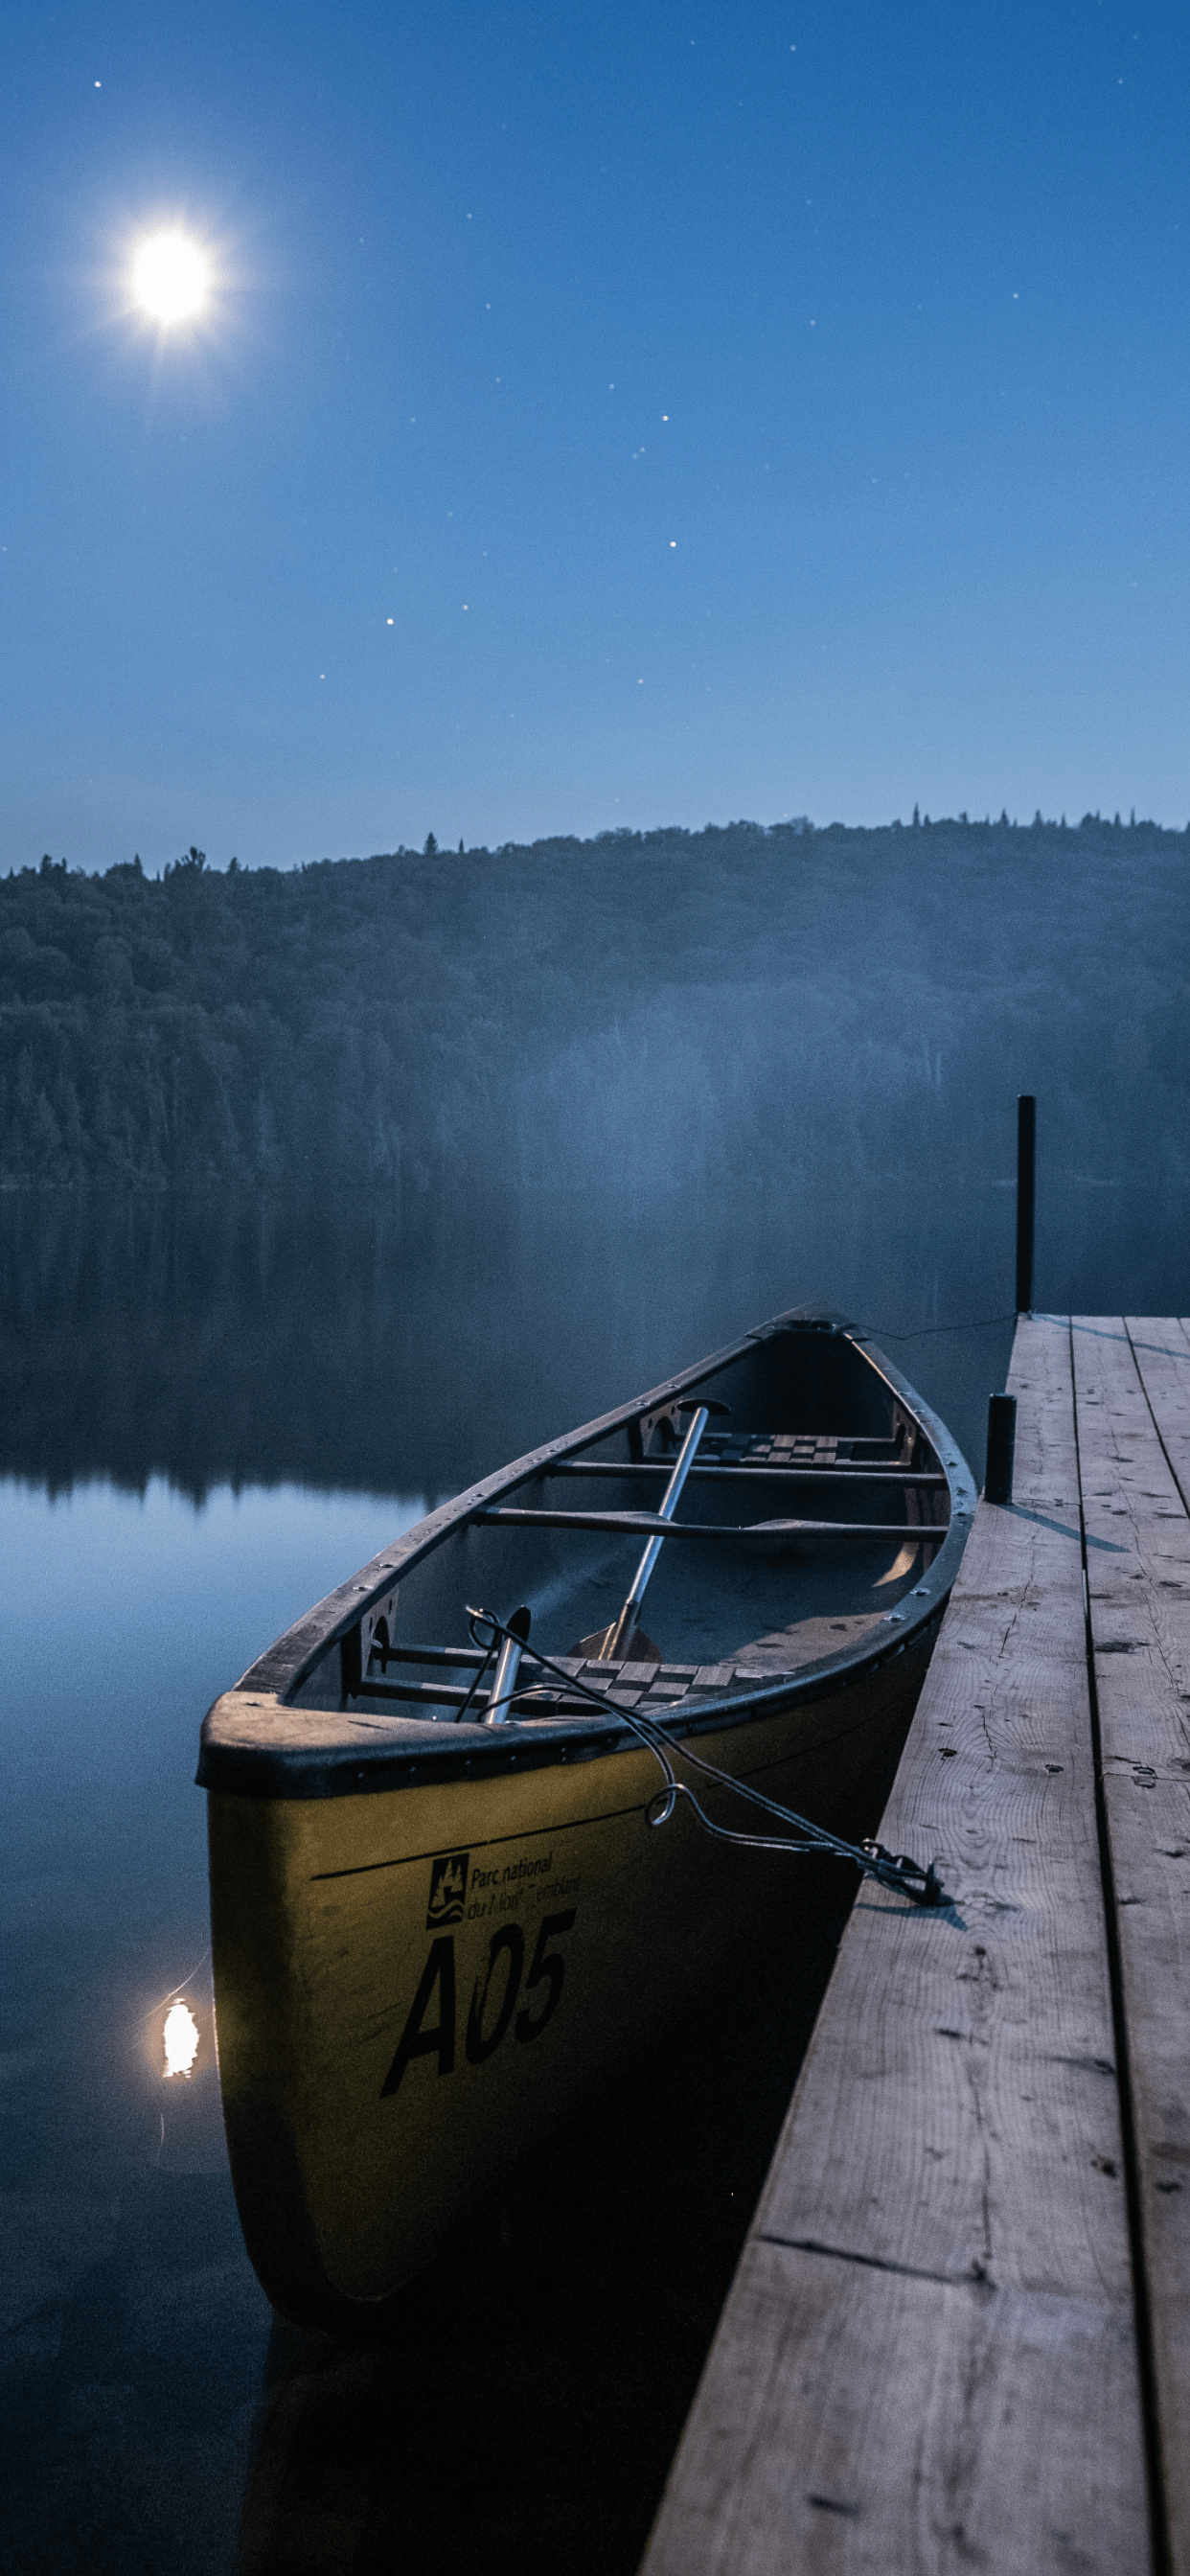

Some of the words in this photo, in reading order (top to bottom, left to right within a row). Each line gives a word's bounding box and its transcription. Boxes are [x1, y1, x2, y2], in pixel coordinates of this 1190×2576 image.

[470, 1864, 499, 1889] Parc
[503, 1851, 553, 1881] national
[468, 1898, 486, 1920] du
[379, 1908, 577, 2099] A05
